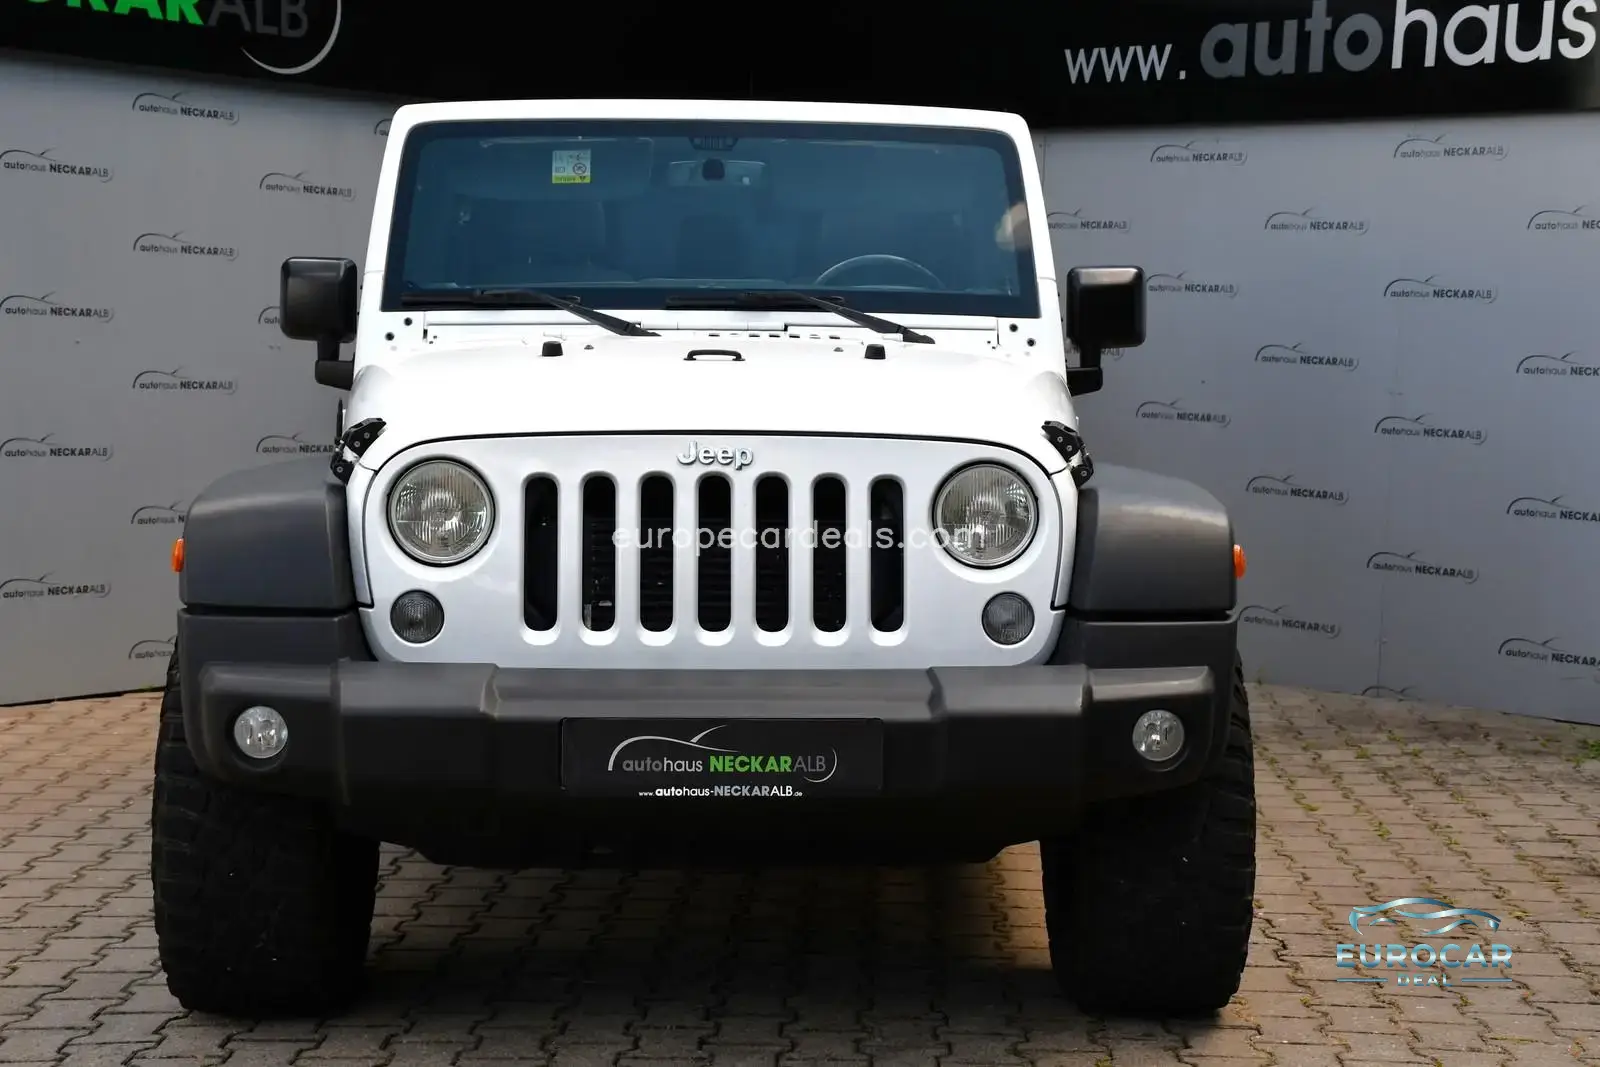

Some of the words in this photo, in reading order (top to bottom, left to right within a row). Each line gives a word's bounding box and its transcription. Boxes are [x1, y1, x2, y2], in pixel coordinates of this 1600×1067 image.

[676, 440, 754, 471] Jeep
[623, 756, 703, 773] autohaus
[709, 755, 826, 773] NECKARALB
